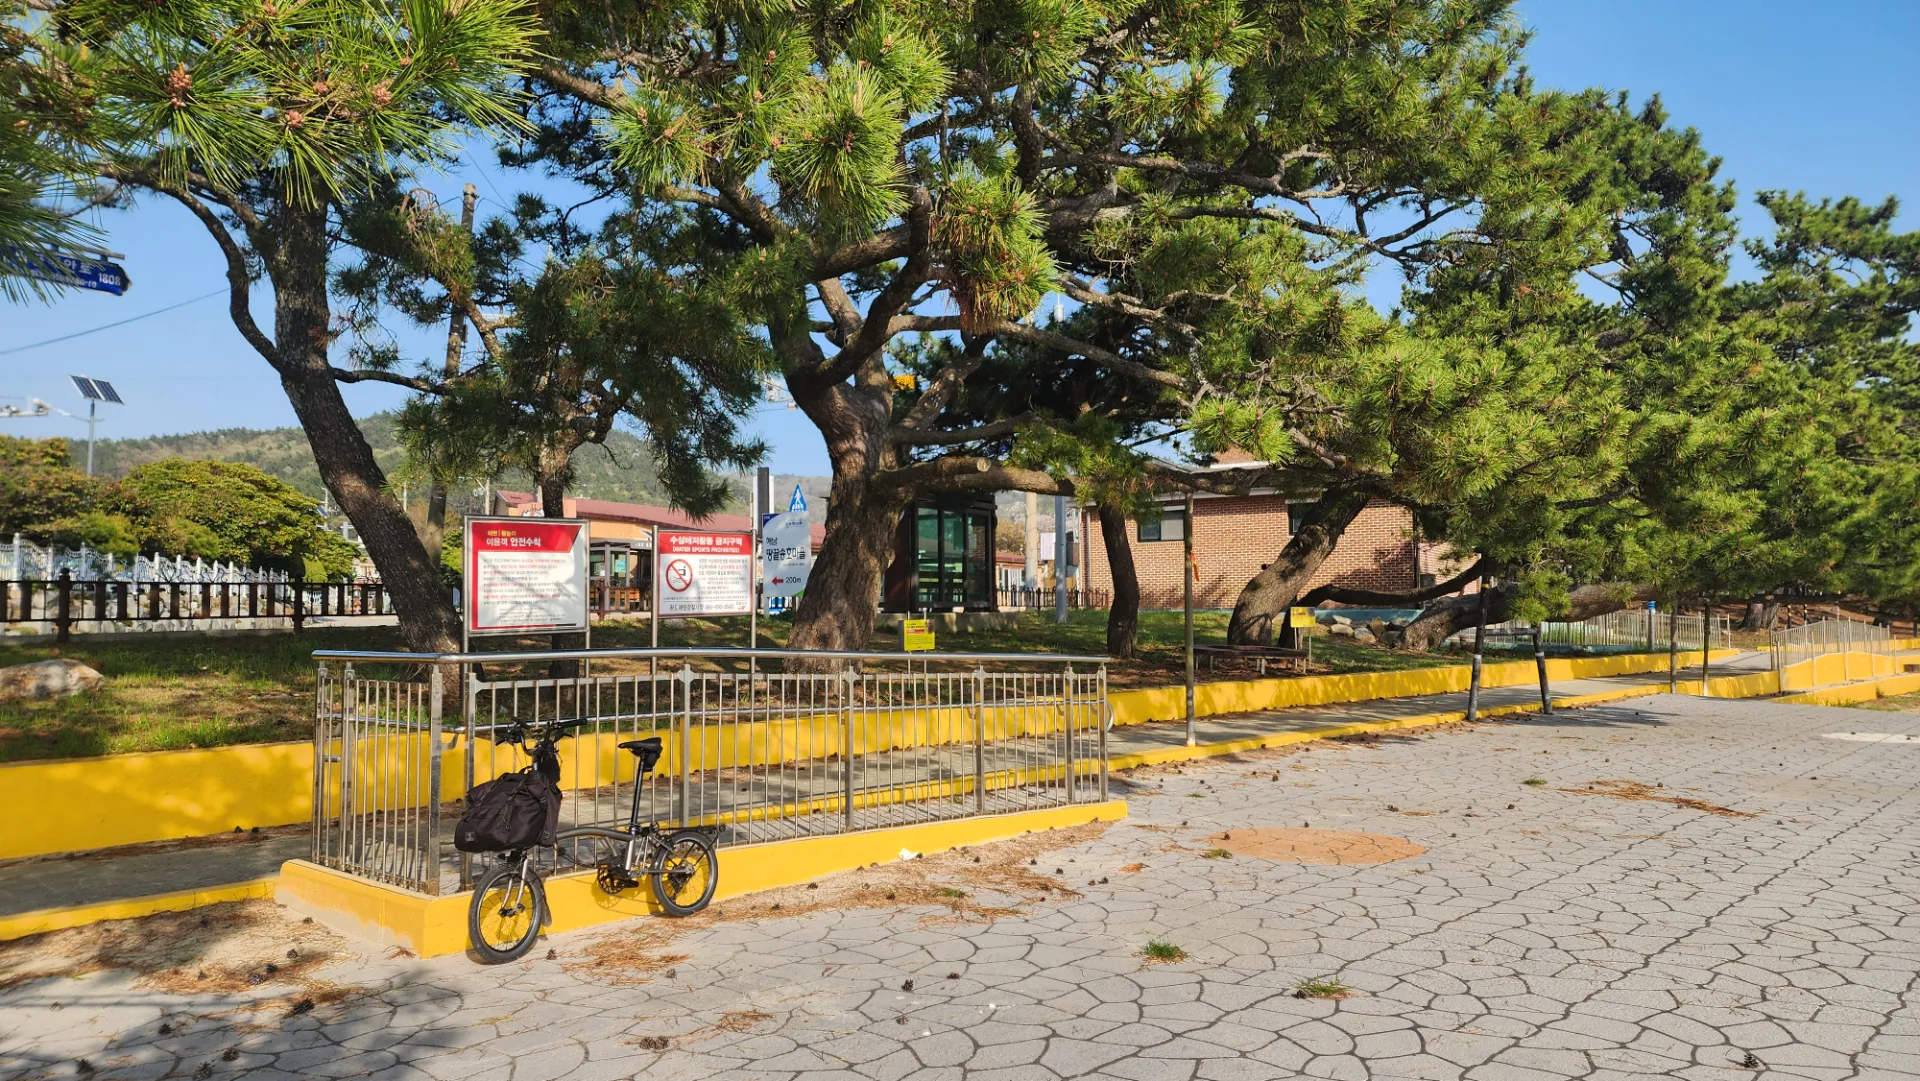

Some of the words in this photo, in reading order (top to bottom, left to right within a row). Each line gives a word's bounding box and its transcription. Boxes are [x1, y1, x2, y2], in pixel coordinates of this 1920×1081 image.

[98, 272, 121, 286] 1808
[486, 538, 508, 547] 이용객
[510, 537, 541, 547] 안전수칙
[715, 537, 743, 547] 금지구역
[766, 537, 778, 546] 해남
[766, 547, 806, 561] 땅끝송호마을
[785, 576, 802, 584] 200m
